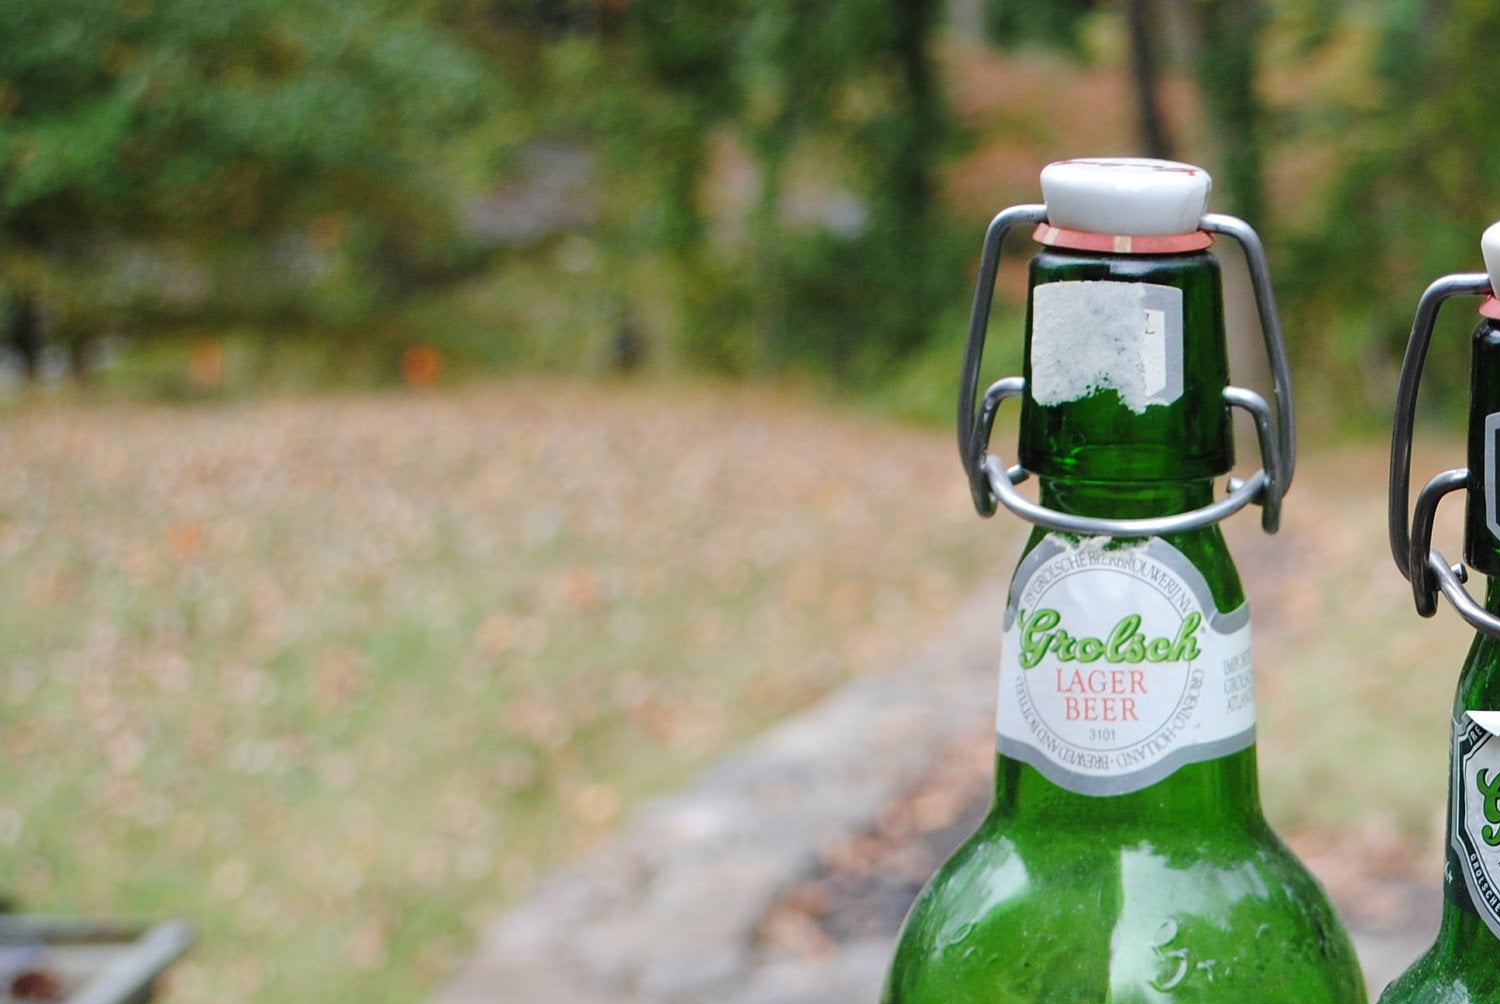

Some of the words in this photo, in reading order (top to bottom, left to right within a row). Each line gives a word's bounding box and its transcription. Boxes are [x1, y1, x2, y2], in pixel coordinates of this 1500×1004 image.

[1017, 608, 1203, 670] Grolsch
[1055, 669, 1148, 695] LAGER
[1064, 697, 1140, 722] BEER
[1088, 728, 1117, 742] 3101
